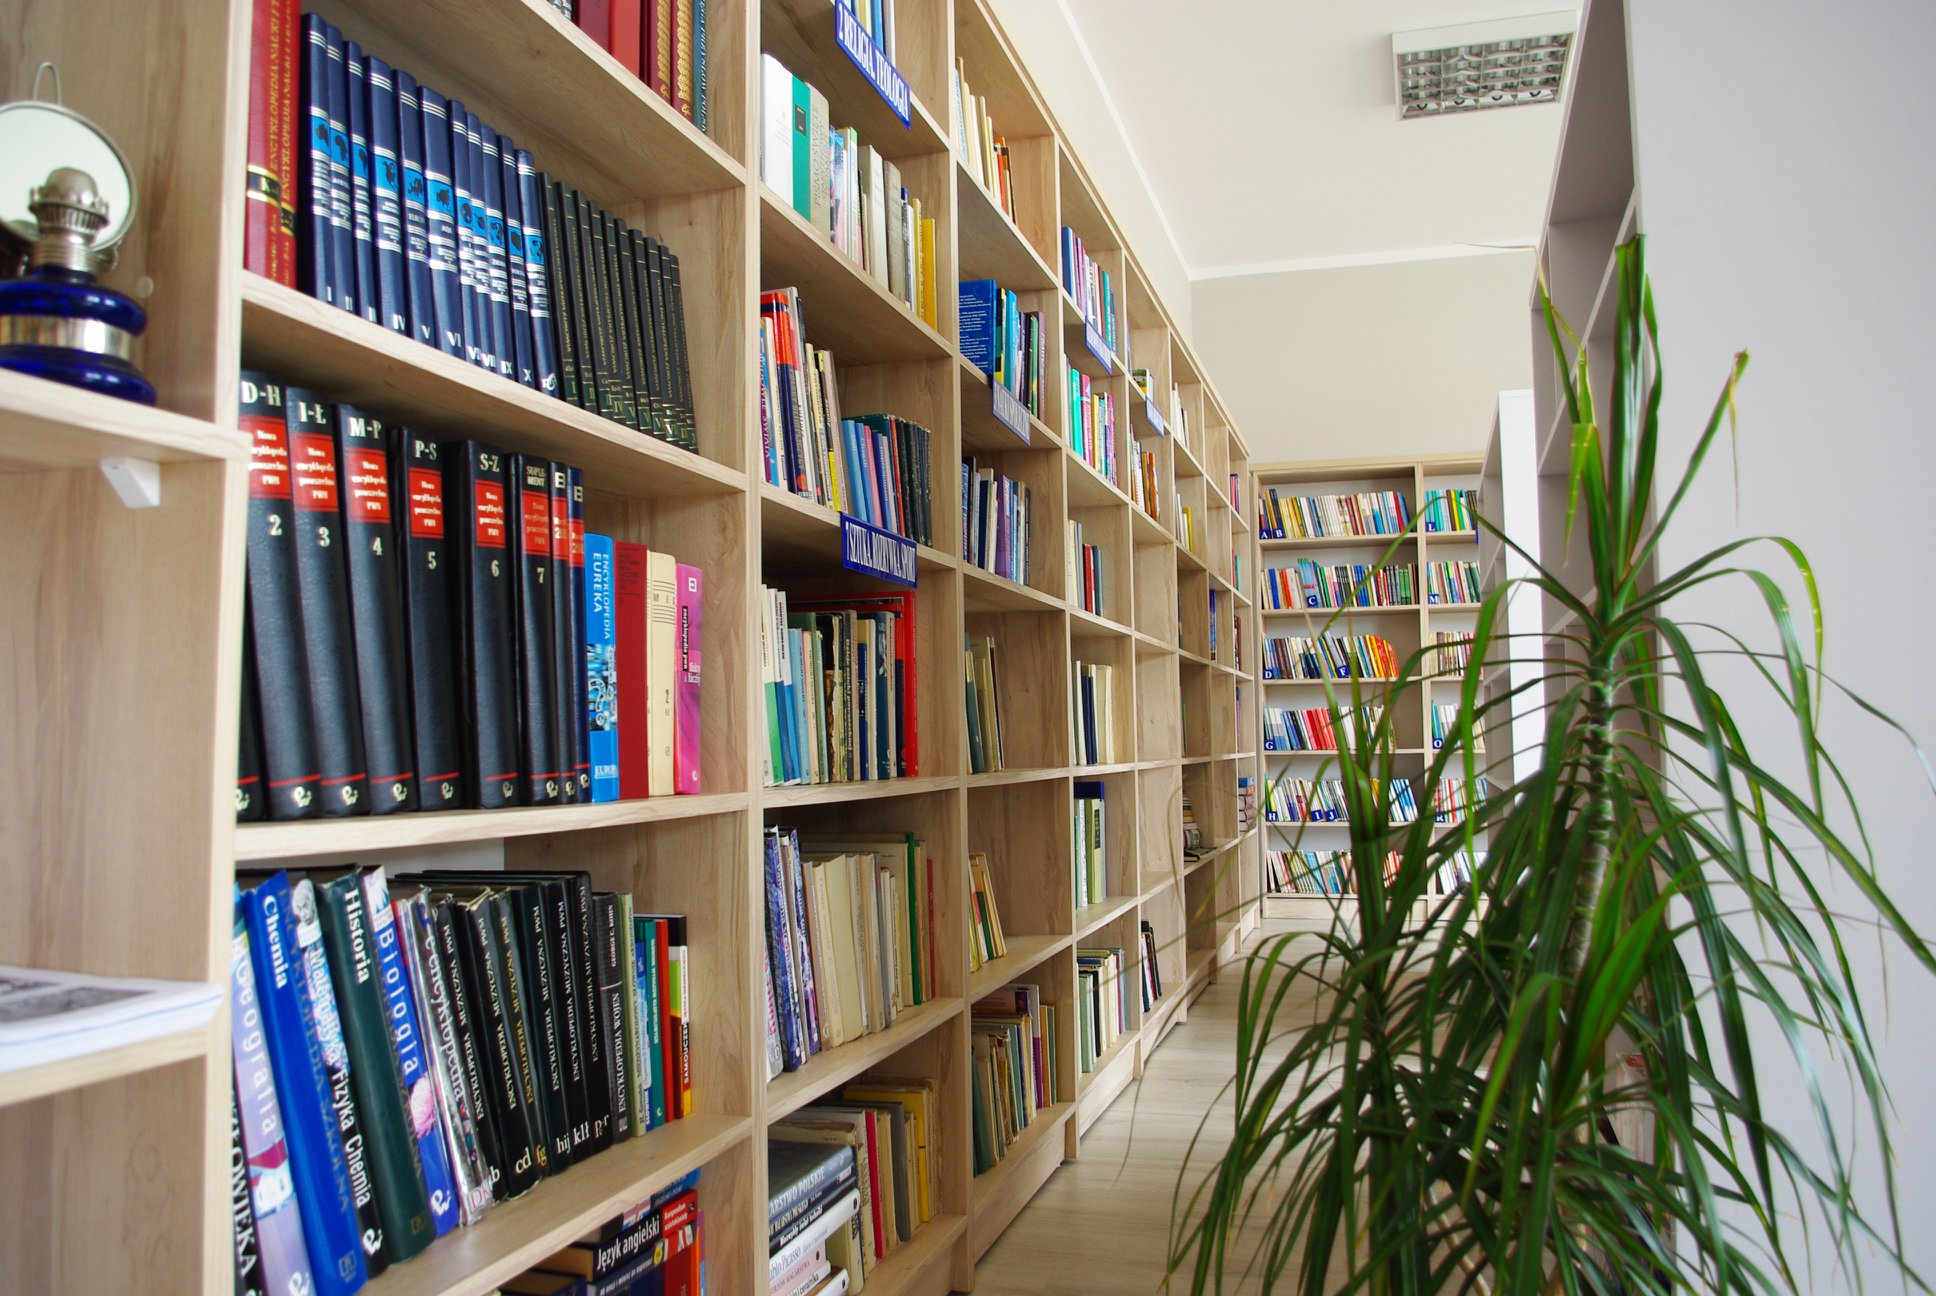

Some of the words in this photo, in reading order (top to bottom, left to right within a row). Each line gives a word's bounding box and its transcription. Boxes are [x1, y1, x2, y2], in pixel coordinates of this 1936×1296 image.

[875, 48, 909, 122] TEOLOGIA
[393, 314, 406, 331] IV
[422, 325, 431, 340] V
[447, 331, 462, 348] VI
[523, 368, 532, 382] X
[241, 381, 281, 406] D-H
[300, 401, 327, 424] I-Ł
[350, 416, 382, 440] M-P
[415, 440, 437, 460] P-S
[480, 453, 500, 472] S-Z
[268, 514, 282, 536] 2
[318, 527, 330, 548] 3
[1261, 530, 1268, 538] A
[1276, 528, 1282, 538] B
[1428, 523, 1436, 532] L
[372, 537, 382, 556] 4
[428, 552, 436, 570] 5
[491, 560, 500, 576] 6
[536, 567, 545, 584] 7
[593, 552, 602, 614] EUREKA
[602, 553, 611, 640] ENCYKLOPEDIA
[1308, 596, 1316, 605] C
[1428, 594, 1439, 604] M
[1265, 670, 1272, 679] D
[1340, 667, 1347, 677] F
[1266, 742, 1274, 750] G
[1434, 740, 1442, 748] O
[1268, 812, 1276, 821] H
[1328, 811, 1335, 820] J
[263, 895, 288, 990] Chemia
[344, 889, 371, 984] Historia
[582, 914, 594, 978] MUZYCZNA
[537, 938, 550, 1002] MUZYCZNA
[562, 933, 572, 996] MUZYCZNA
[451, 958, 468, 1026] MUZYCZNA
[484, 951, 501, 1017] MUZYCZNA
[507, 949, 521, 1013] MUZYCZNA
[379, 926, 418, 1076] Biologia
[612, 992, 621, 1024] WOJEN
[588, 979, 600, 1062] ENCYKLOPEDIA
[235, 963, 277, 1135] Geografia
[544, 1007, 560, 1092] ENCYKLOPEDIA
[566, 997, 581, 1083] ENCYKLOPEDIA
[516, 1020, 534, 1104] ENCYKLOPEDIA
[682, 1022, 690, 1084] SAMOUCZEK
[464, 1032, 485, 1121] ENCYKLOPEDIA
[497, 1023, 517, 1110] ENCYKLOPEDIA
[614, 1026, 626, 1114] ENCYKLOPEDIA
[332, 1069, 355, 1131] Fizyka
[345, 1134, 372, 1210] Chemia
[556, 1132, 571, 1154] hij
[515, 1146, 532, 1174] cd
[769, 1186, 798, 1216] ARSTWO
[597, 1238, 622, 1272] Język
[622, 1214, 660, 1252] angielski
